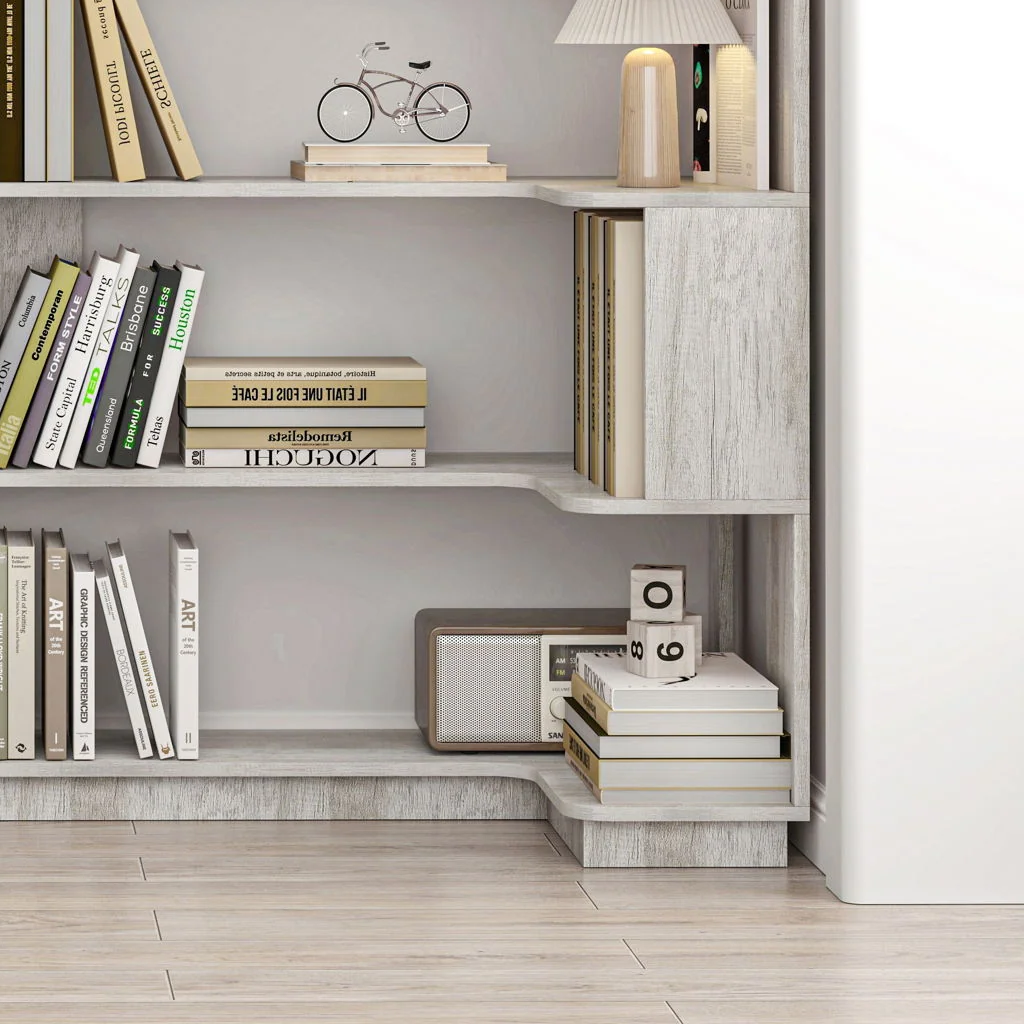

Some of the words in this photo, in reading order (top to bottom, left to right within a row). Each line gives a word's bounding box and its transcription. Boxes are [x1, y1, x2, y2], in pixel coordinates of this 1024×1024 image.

[18, 295, 36, 328] Columbia
[31, 289, 64, 361] Contemporan
[47, 341, 66, 381] FORM
[62, 295, 82, 338] STYLE
[75, 275, 113, 354] Harrisburg
[120, 285, 148, 352] Brisbane
[168, 289, 196, 351] Houston
[82, 367, 101, 407] TED
[95, 277, 129, 356] TALKS
[124, 398, 144, 450] FORMULA
[143, 354, 155, 377] FOR
[152, 286, 171, 336] SUCCESS
[45, 421, 62, 451] State
[56, 377, 77, 417] Capital
[96, 397, 117, 453] Queensland
[147, 415, 164, 448] Tehas
[49, 598, 64, 631] ART
[80, 588, 88, 627] GRAPHIC
[181, 599, 196, 632] ART
[80, 630, 88, 662] DESIGN
[139, 650, 153, 688] SAARINEN
[80, 665, 88, 723] REFERENCED
[148, 690, 159, 708] EERO
